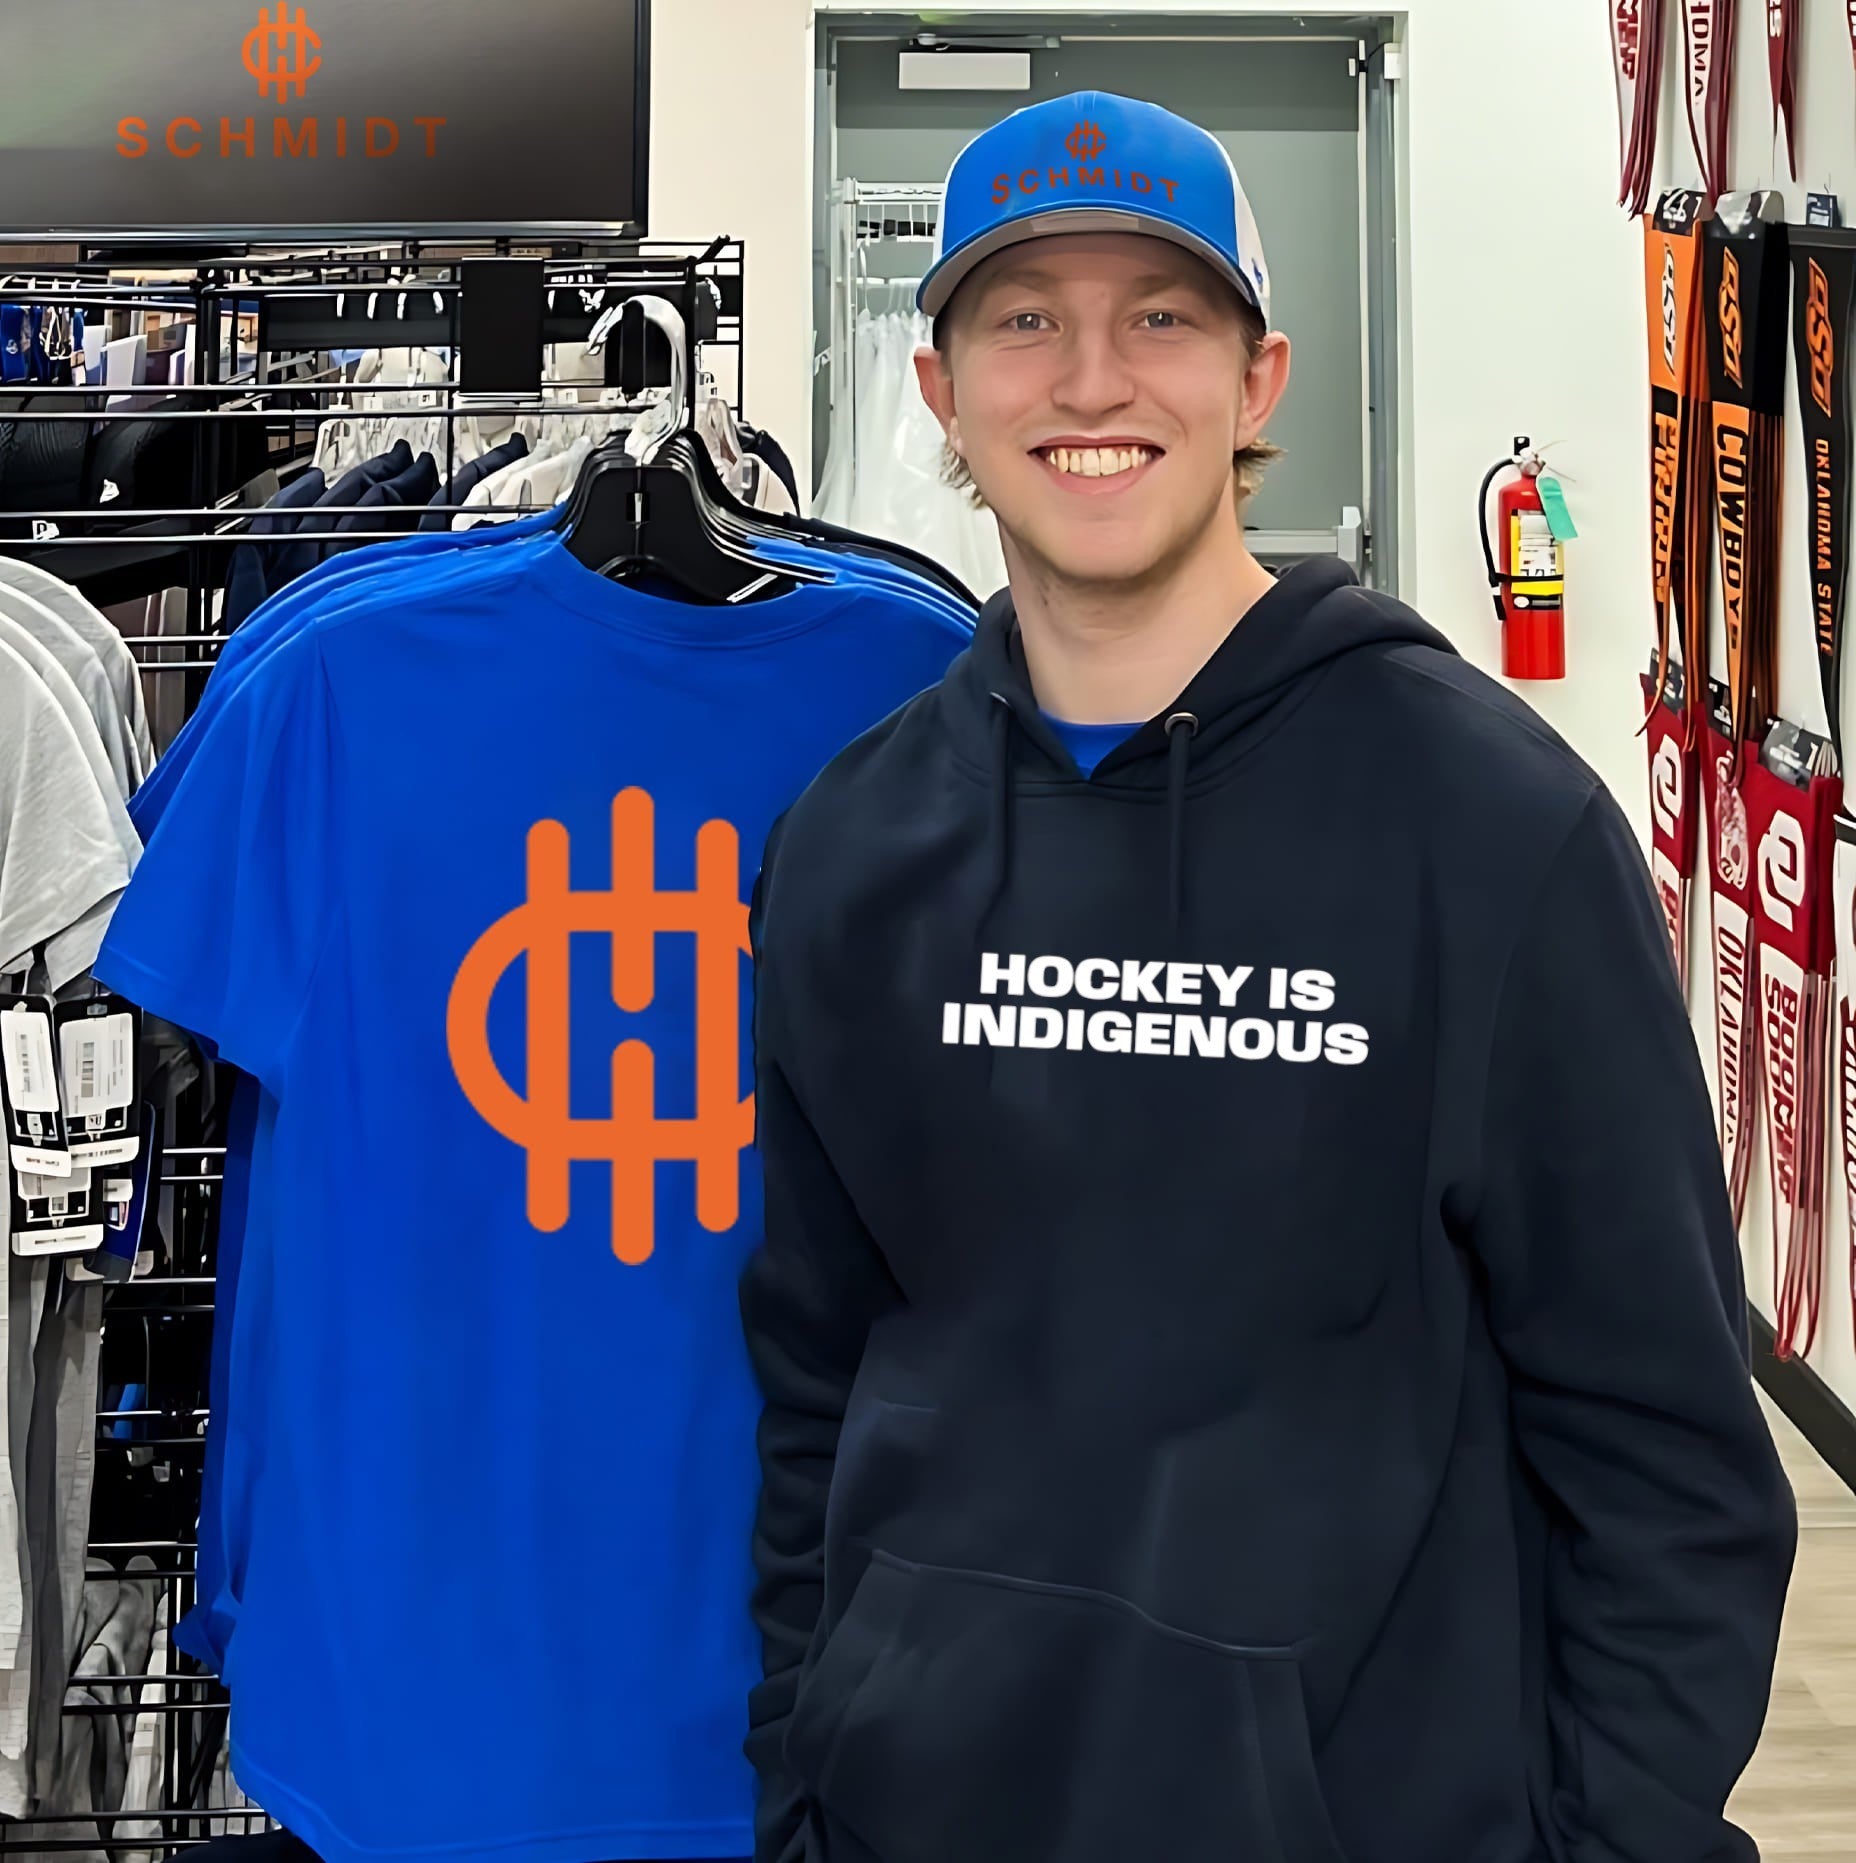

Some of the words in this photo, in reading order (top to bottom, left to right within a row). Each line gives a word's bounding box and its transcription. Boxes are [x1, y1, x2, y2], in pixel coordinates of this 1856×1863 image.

[116, 116, 447, 158] SCHMIDT
[991, 166, 1179, 205] SCHMIDT
[1815, 438, 1832, 571] OKLAHOMA
[980, 952, 1254, 1007] HOCKEY
[1269, 968, 1336, 1011] IS
[942, 1002, 1370, 1065] INDIGENOUS
